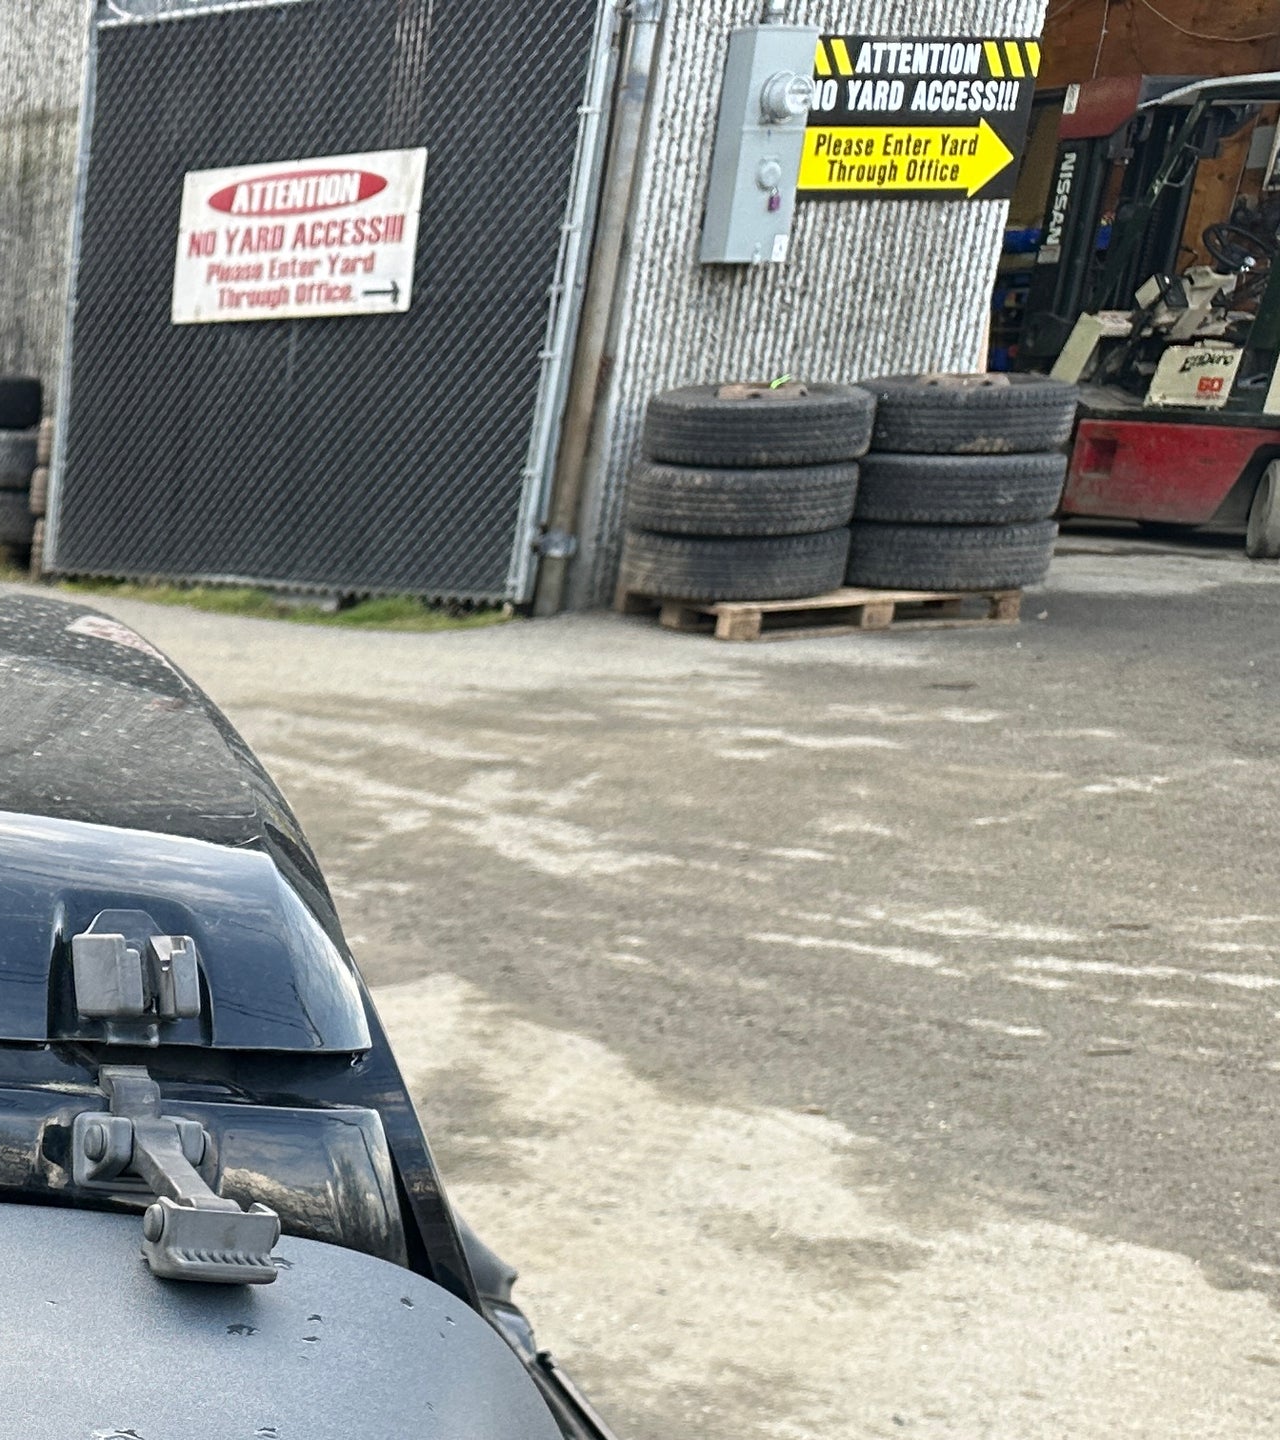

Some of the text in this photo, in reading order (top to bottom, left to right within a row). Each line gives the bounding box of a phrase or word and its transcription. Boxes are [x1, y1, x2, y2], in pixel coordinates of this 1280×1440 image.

[855, 42, 983, 75] ATTENTION
[847, 79, 906, 112] YARD
[910, 80, 1020, 112] ACCESS!!!
[814, 133, 979, 156] Please Enter Yard
[827, 159, 960, 185] Through Office
[231, 172, 361, 214] ATTENTION
[1046, 152, 1077, 245] NISSAN
[188, 214, 406, 257] NO YARD ACCESS!!!
[268, 256, 321, 279] Enter
[327, 252, 377, 276] Yard
